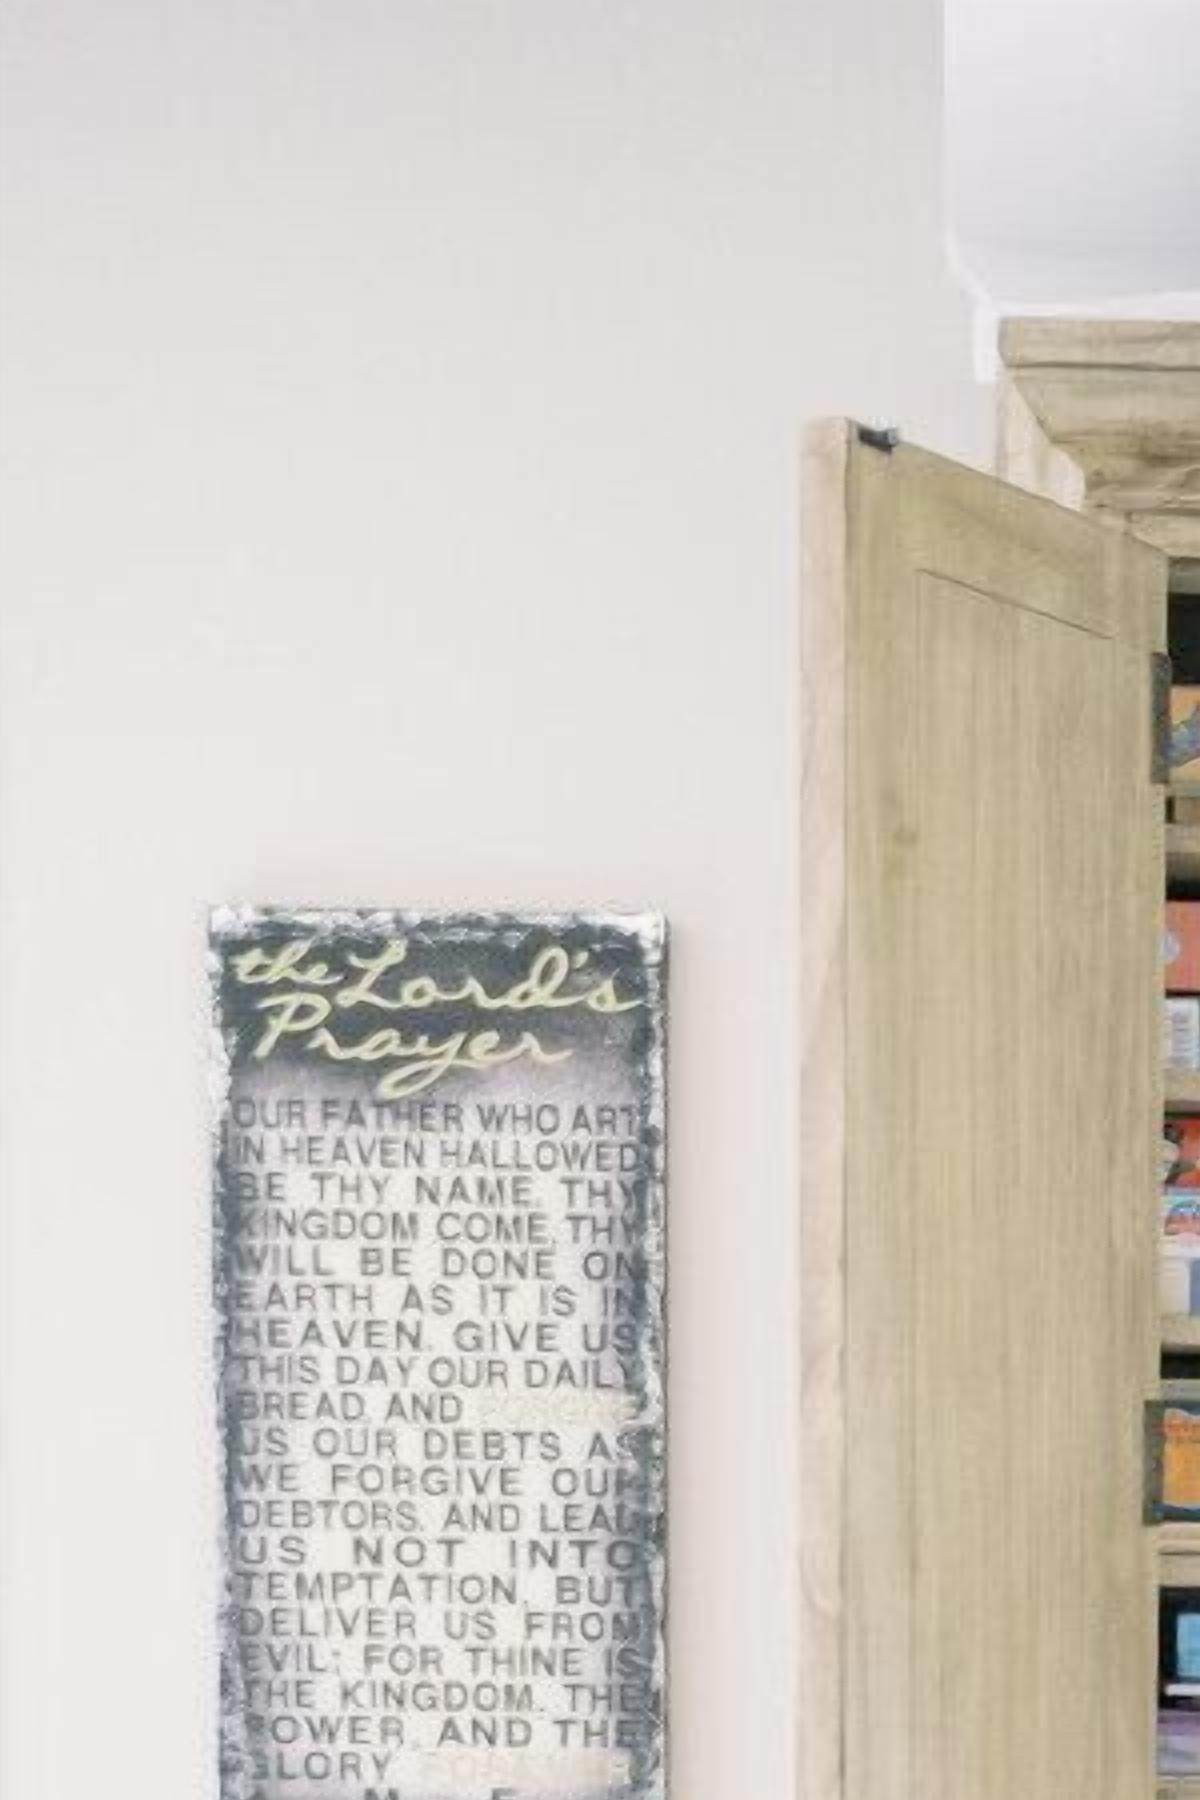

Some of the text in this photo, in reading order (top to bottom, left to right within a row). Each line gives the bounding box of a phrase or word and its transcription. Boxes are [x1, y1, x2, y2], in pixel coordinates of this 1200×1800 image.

[231, 937, 646, 1013] the Lord's
[254, 992, 574, 1099] Prayer
[233, 1100, 639, 1135] OUR FATHER WHO ART
[281, 1137, 426, 1168] HEAVEN
[440, 1140, 640, 1172] HALLOWED
[236, 1172, 286, 1201] BE
[310, 1173, 390, 1204] THY
[360, 1248, 414, 1277] BE
[441, 1248, 556, 1281] DONE
[235, 1281, 374, 1312] EARTH
[402, 1283, 454, 1316] AS
[479, 1285, 515, 1316] IT
[539, 1286, 577, 1318] IS
[452, 1321, 560, 1353] GIVE
[582, 1324, 638, 1354] US
[233, 1355, 320, 1385] THIS
[336, 1356, 418, 1388] DAY
[427, 1357, 509, 1389] OUR
[385, 1392, 463, 1424] AND
[311, 1428, 398, 1458] OUR
[423, 1428, 561, 1462] DEBTS
[235, 1464, 301, 1492] WE
[331, 1464, 522, 1497] FORGIVE
[442, 1504, 521, 1533] AND
[237, 1536, 639, 1570] US NOT INTO
[555, 1576, 636, 1607] BUT
[238, 1607, 417, 1639] DELIVER
[443, 1611, 497, 1641] US
[363, 1644, 444, 1676] FOR
[464, 1647, 582, 1677] THINE
[605, 1648, 643, 1678] IS
[245, 1680, 315, 1709] THE
[563, 1684, 643, 1714] THE
[437, 1716, 533, 1749] AND
[553, 1719, 636, 1749] THE
